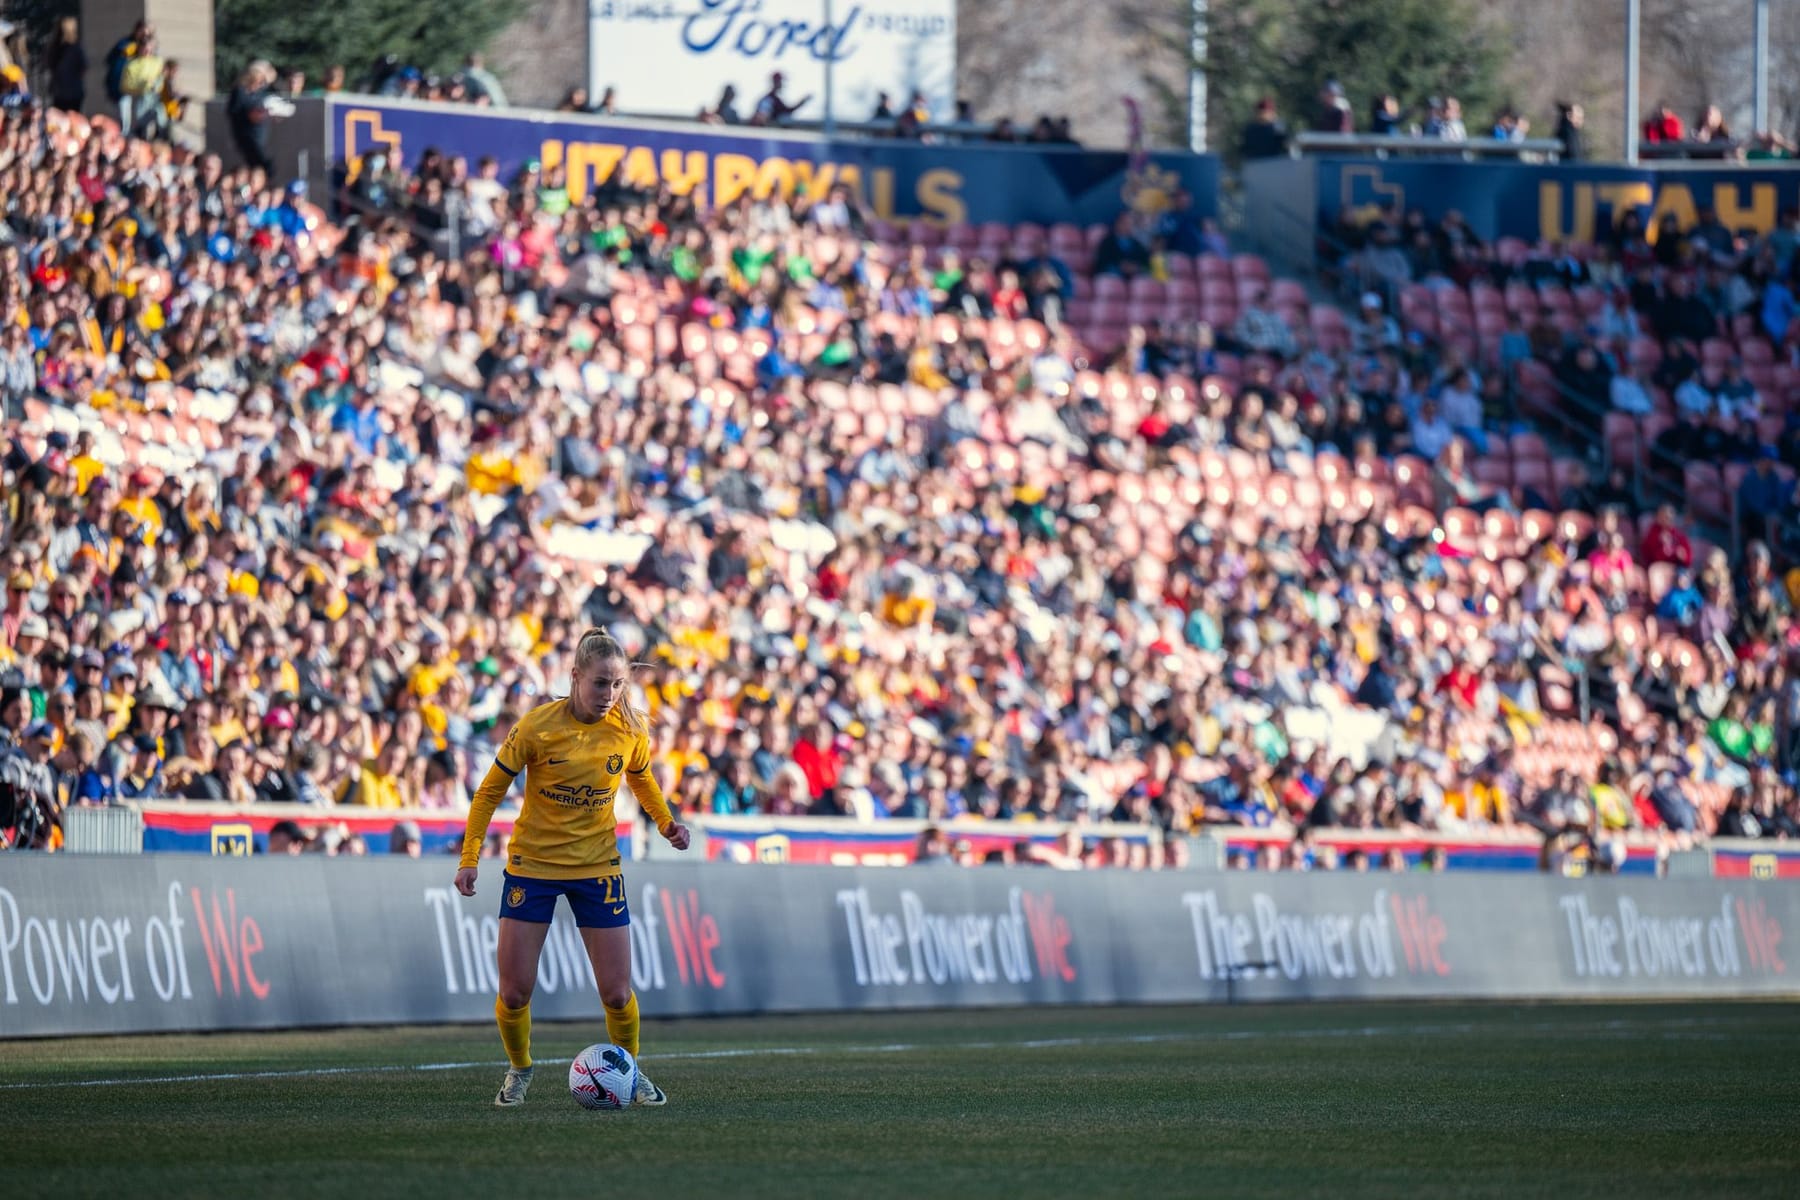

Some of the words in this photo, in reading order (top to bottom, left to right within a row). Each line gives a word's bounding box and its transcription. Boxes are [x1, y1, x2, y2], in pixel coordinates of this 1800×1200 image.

[683, 0, 861, 61] Ford
[541, 139, 708, 210] UTAH
[713, 152, 968, 227] ROYLS
[1540, 180, 1777, 246] UTAH
[539, 788, 589, 807] AMERICA
[0, 886, 134, 1005] Power
[145, 880, 192, 1001] of
[191, 887, 271, 999] We
[631, 882, 666, 991] of
[660, 888, 725, 989] We
[836, 886, 909, 985] The
[901, 889, 997, 985] Power
[996, 886, 1032, 983] of
[1022, 891, 1076, 982] We
[1181, 889, 1256, 980] The
[1253, 892, 1356, 980] Power
[1358, 889, 1395, 978] of
[1390, 892, 1451, 977] We
[1559, 893, 1622, 977] The
[1617, 895, 1706, 977] Power
[1708, 893, 1741, 977] of
[1735, 896, 1786, 975] We
